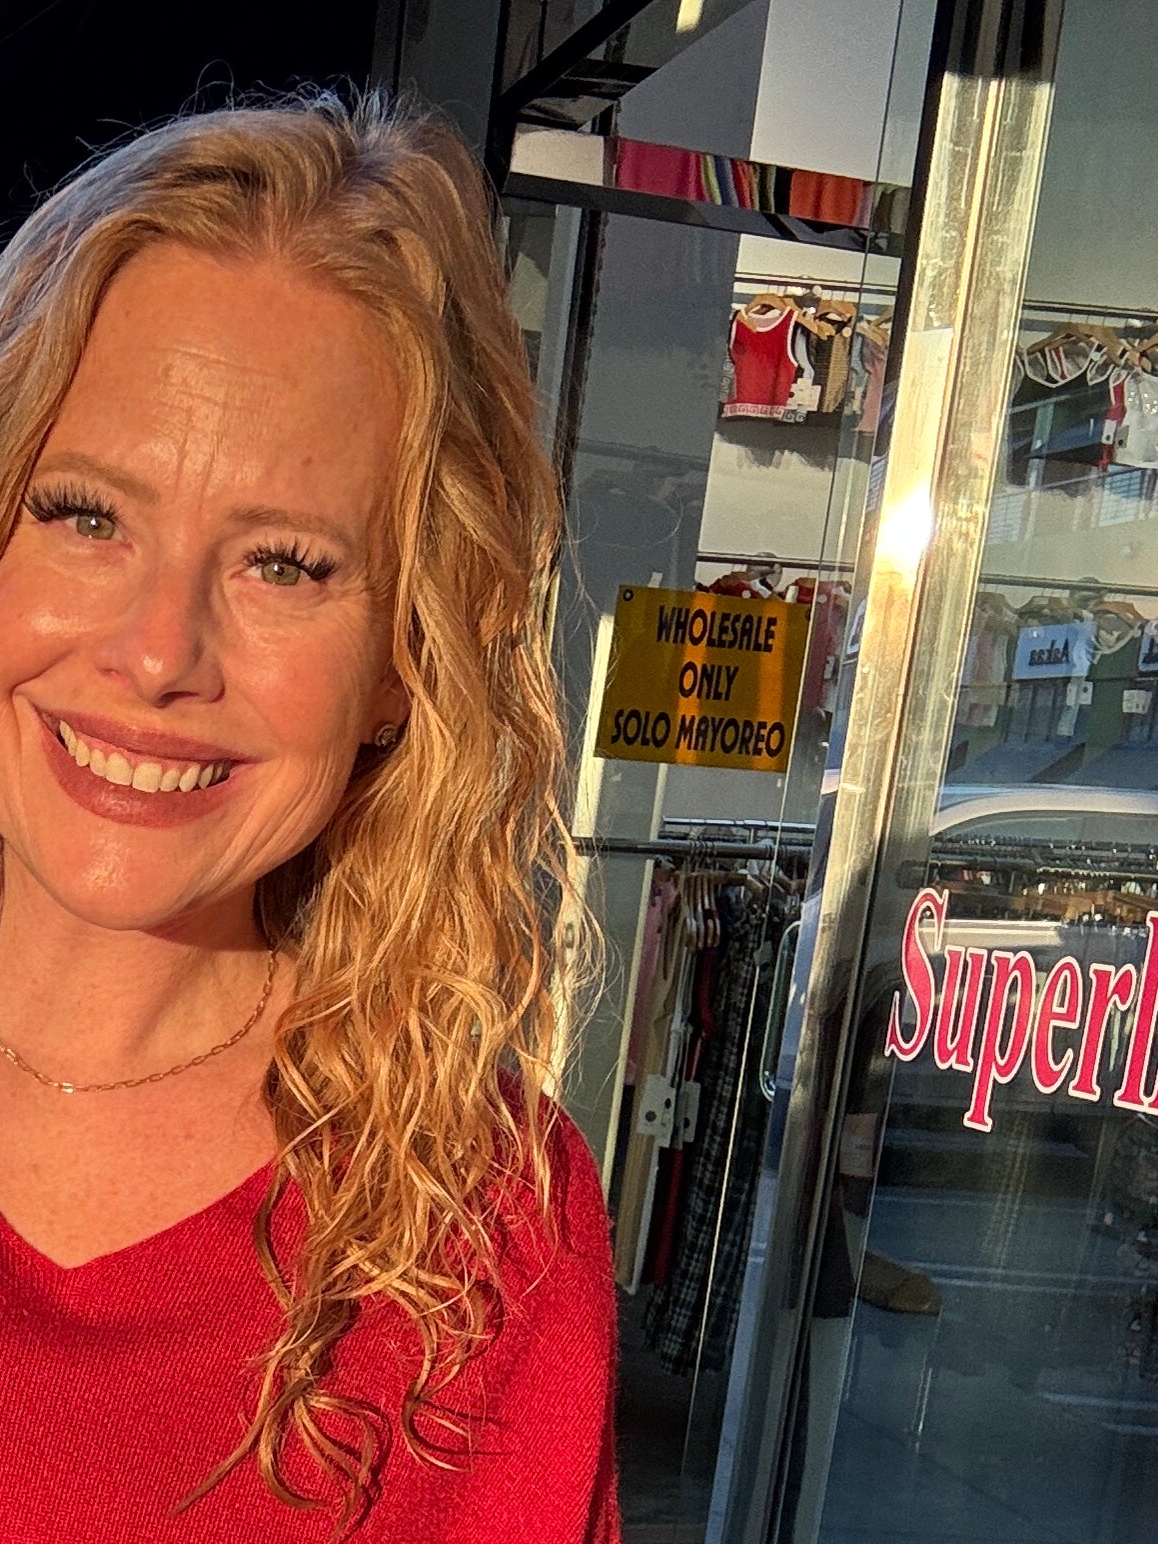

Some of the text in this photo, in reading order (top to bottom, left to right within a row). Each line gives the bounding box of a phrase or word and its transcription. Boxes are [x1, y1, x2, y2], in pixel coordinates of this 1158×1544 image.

[657, 605, 778, 652] WHOLESALE
[679, 661, 739, 701] ONLY
[611, 709, 786, 758] SOLO MAYOREO
